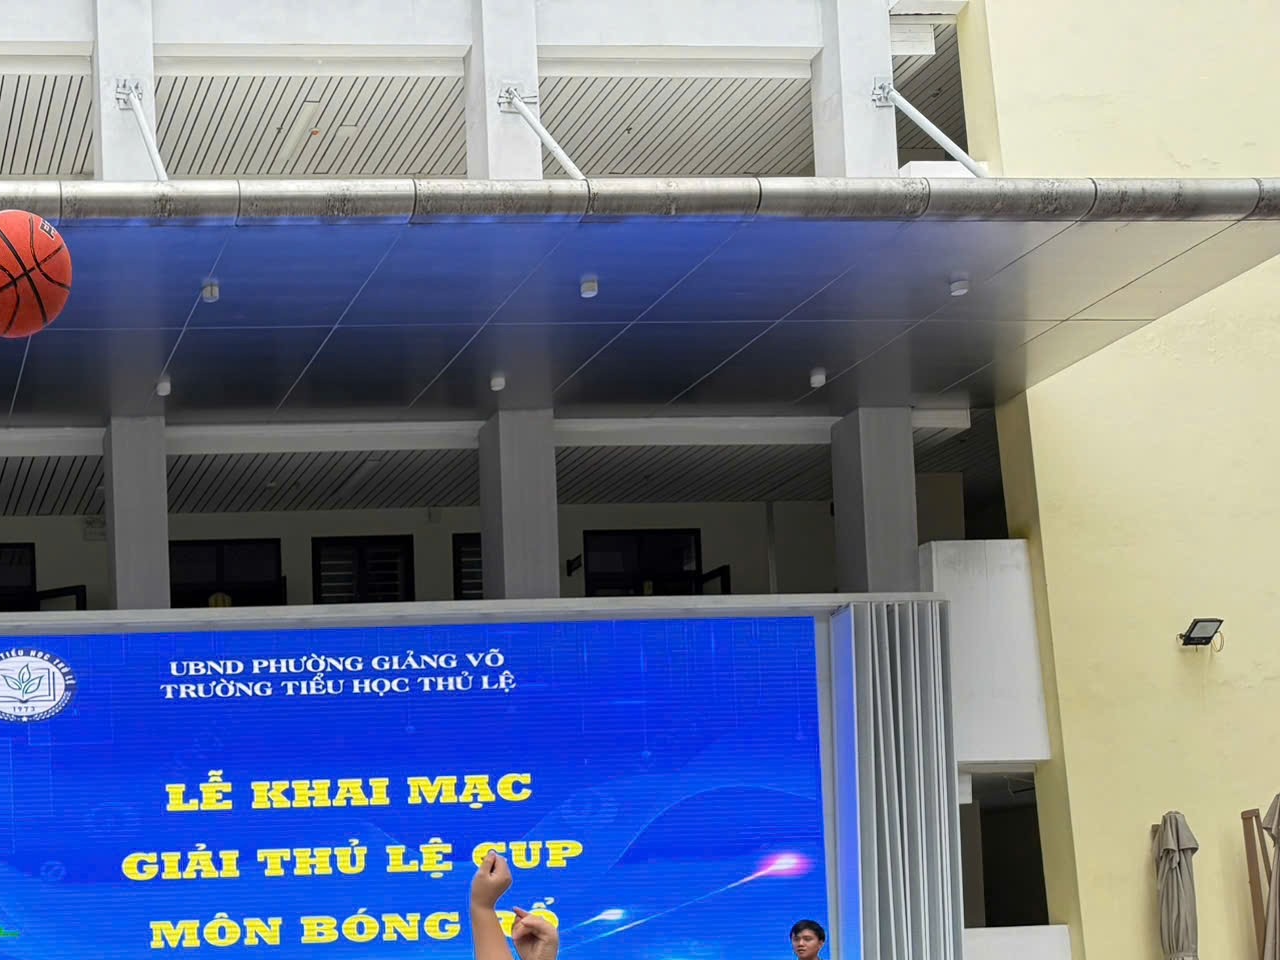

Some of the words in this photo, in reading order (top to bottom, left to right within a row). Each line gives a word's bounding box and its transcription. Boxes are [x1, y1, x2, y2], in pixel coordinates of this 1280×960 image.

[170, 660, 244, 676] UBND
[252, 655, 363, 674] PHƯỜNG
[372, 650, 458, 671] GIẢNG
[465, 649, 505, 667] VÕ
[160, 680, 272, 699] TRƯỜNG
[280, 672, 344, 696] TIỂU
[352, 677, 409, 697] HỌC
[417, 671, 473, 690] THỦ
[480, 671, 516, 697] LỆ
[165, 770, 233, 812] LỄ
[251, 778, 390, 809] KHAI
[407, 772, 533, 809] MẠC
[121, 843, 240, 880] GIẢI
[256, 838, 368, 876] THỦ
[386, 837, 453, 878] LỆ
[472, 840, 583, 869] CUP
[150, 912, 283, 949] MÔN
[300, 907, 461, 944] BÓNG
